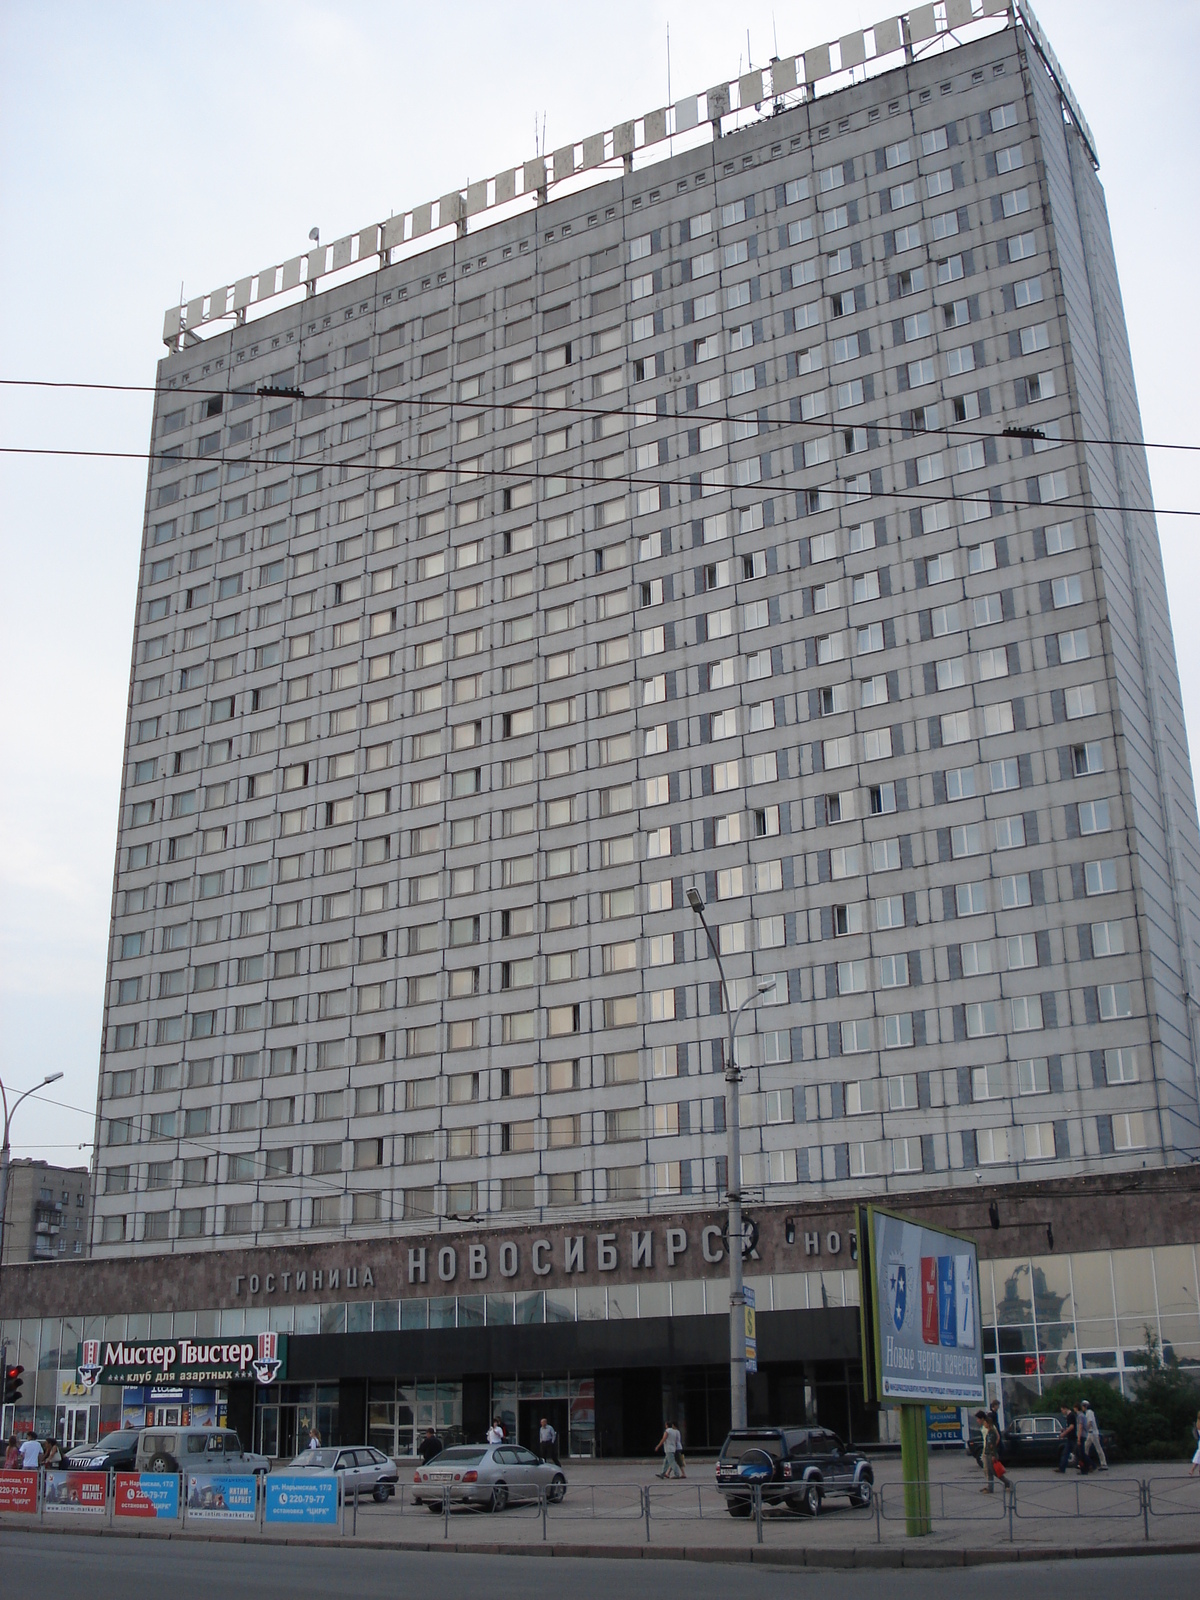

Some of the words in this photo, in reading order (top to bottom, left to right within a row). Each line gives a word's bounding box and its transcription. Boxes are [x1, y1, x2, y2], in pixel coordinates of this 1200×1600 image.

[236, 1267, 374, 1295] ГОСТИНИЦА
[408, 1221, 760, 1284] НОВОСИБИРСК
[104, 1342, 176, 1371] Мистер
[178, 1340, 254, 1370] Твистер
[886, 1336, 914, 1370] Новые
[917, 1350, 942, 1379] черты
[945, 1354, 978, 1377] качества
[127, 1371, 152, 1384] клуб
[155, 1373, 175, 1383] для
[179, 1371, 233, 1383] азартных
[931, 1431, 958, 1439] HOTEL
[82, 1483, 103, 1492] ИНТИМ-
[82, 1492, 103, 1500] МАРКЕТ
[136, 1490, 168, 1499] 220-79-77
[289, 1494, 325, 1503] 220-79-77
[229, 1495, 252, 1504] МАРКЕТ
[47, 1505, 105, 1513] www.intim-market.ru
[189, 1511, 254, 1519] www.intim-market.ru
